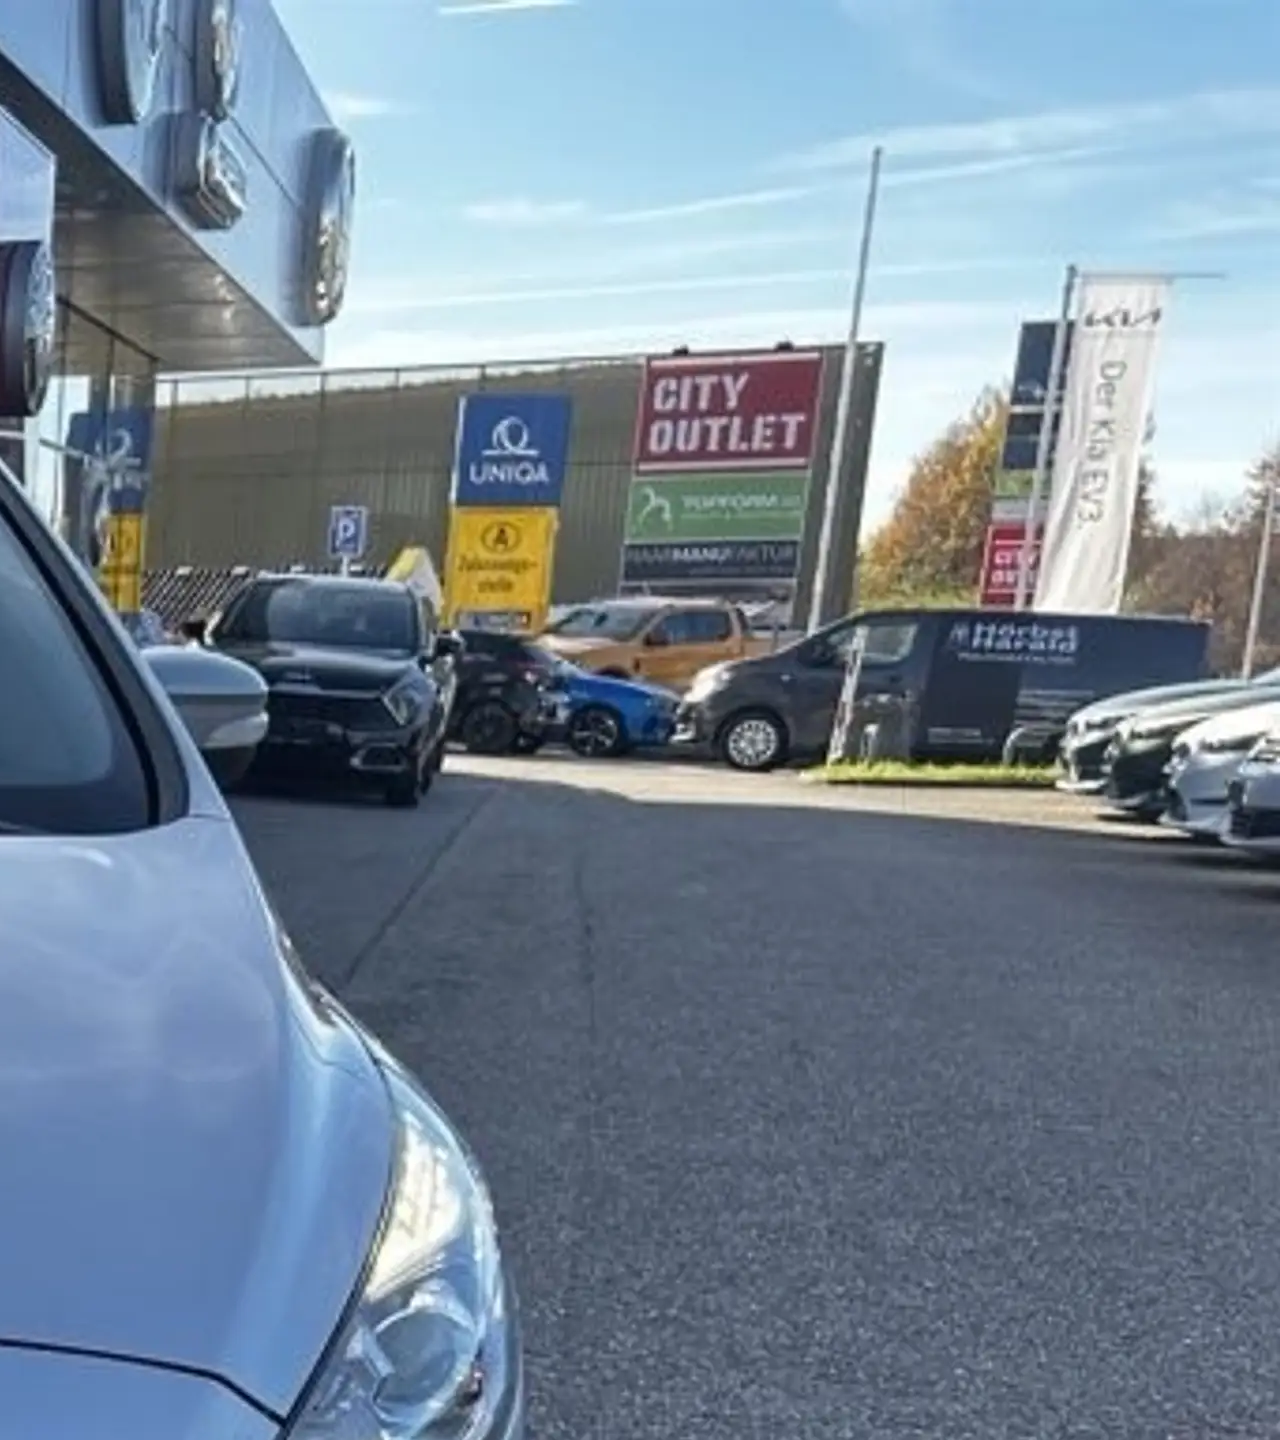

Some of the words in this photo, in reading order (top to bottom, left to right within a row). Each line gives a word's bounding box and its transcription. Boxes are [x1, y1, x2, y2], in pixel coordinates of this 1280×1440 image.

[653, 372, 749, 412] CITY
[1095, 359, 1127, 409] Der
[649, 413, 806, 454] OUTLET
[469, 461, 549, 485] UNIQA
